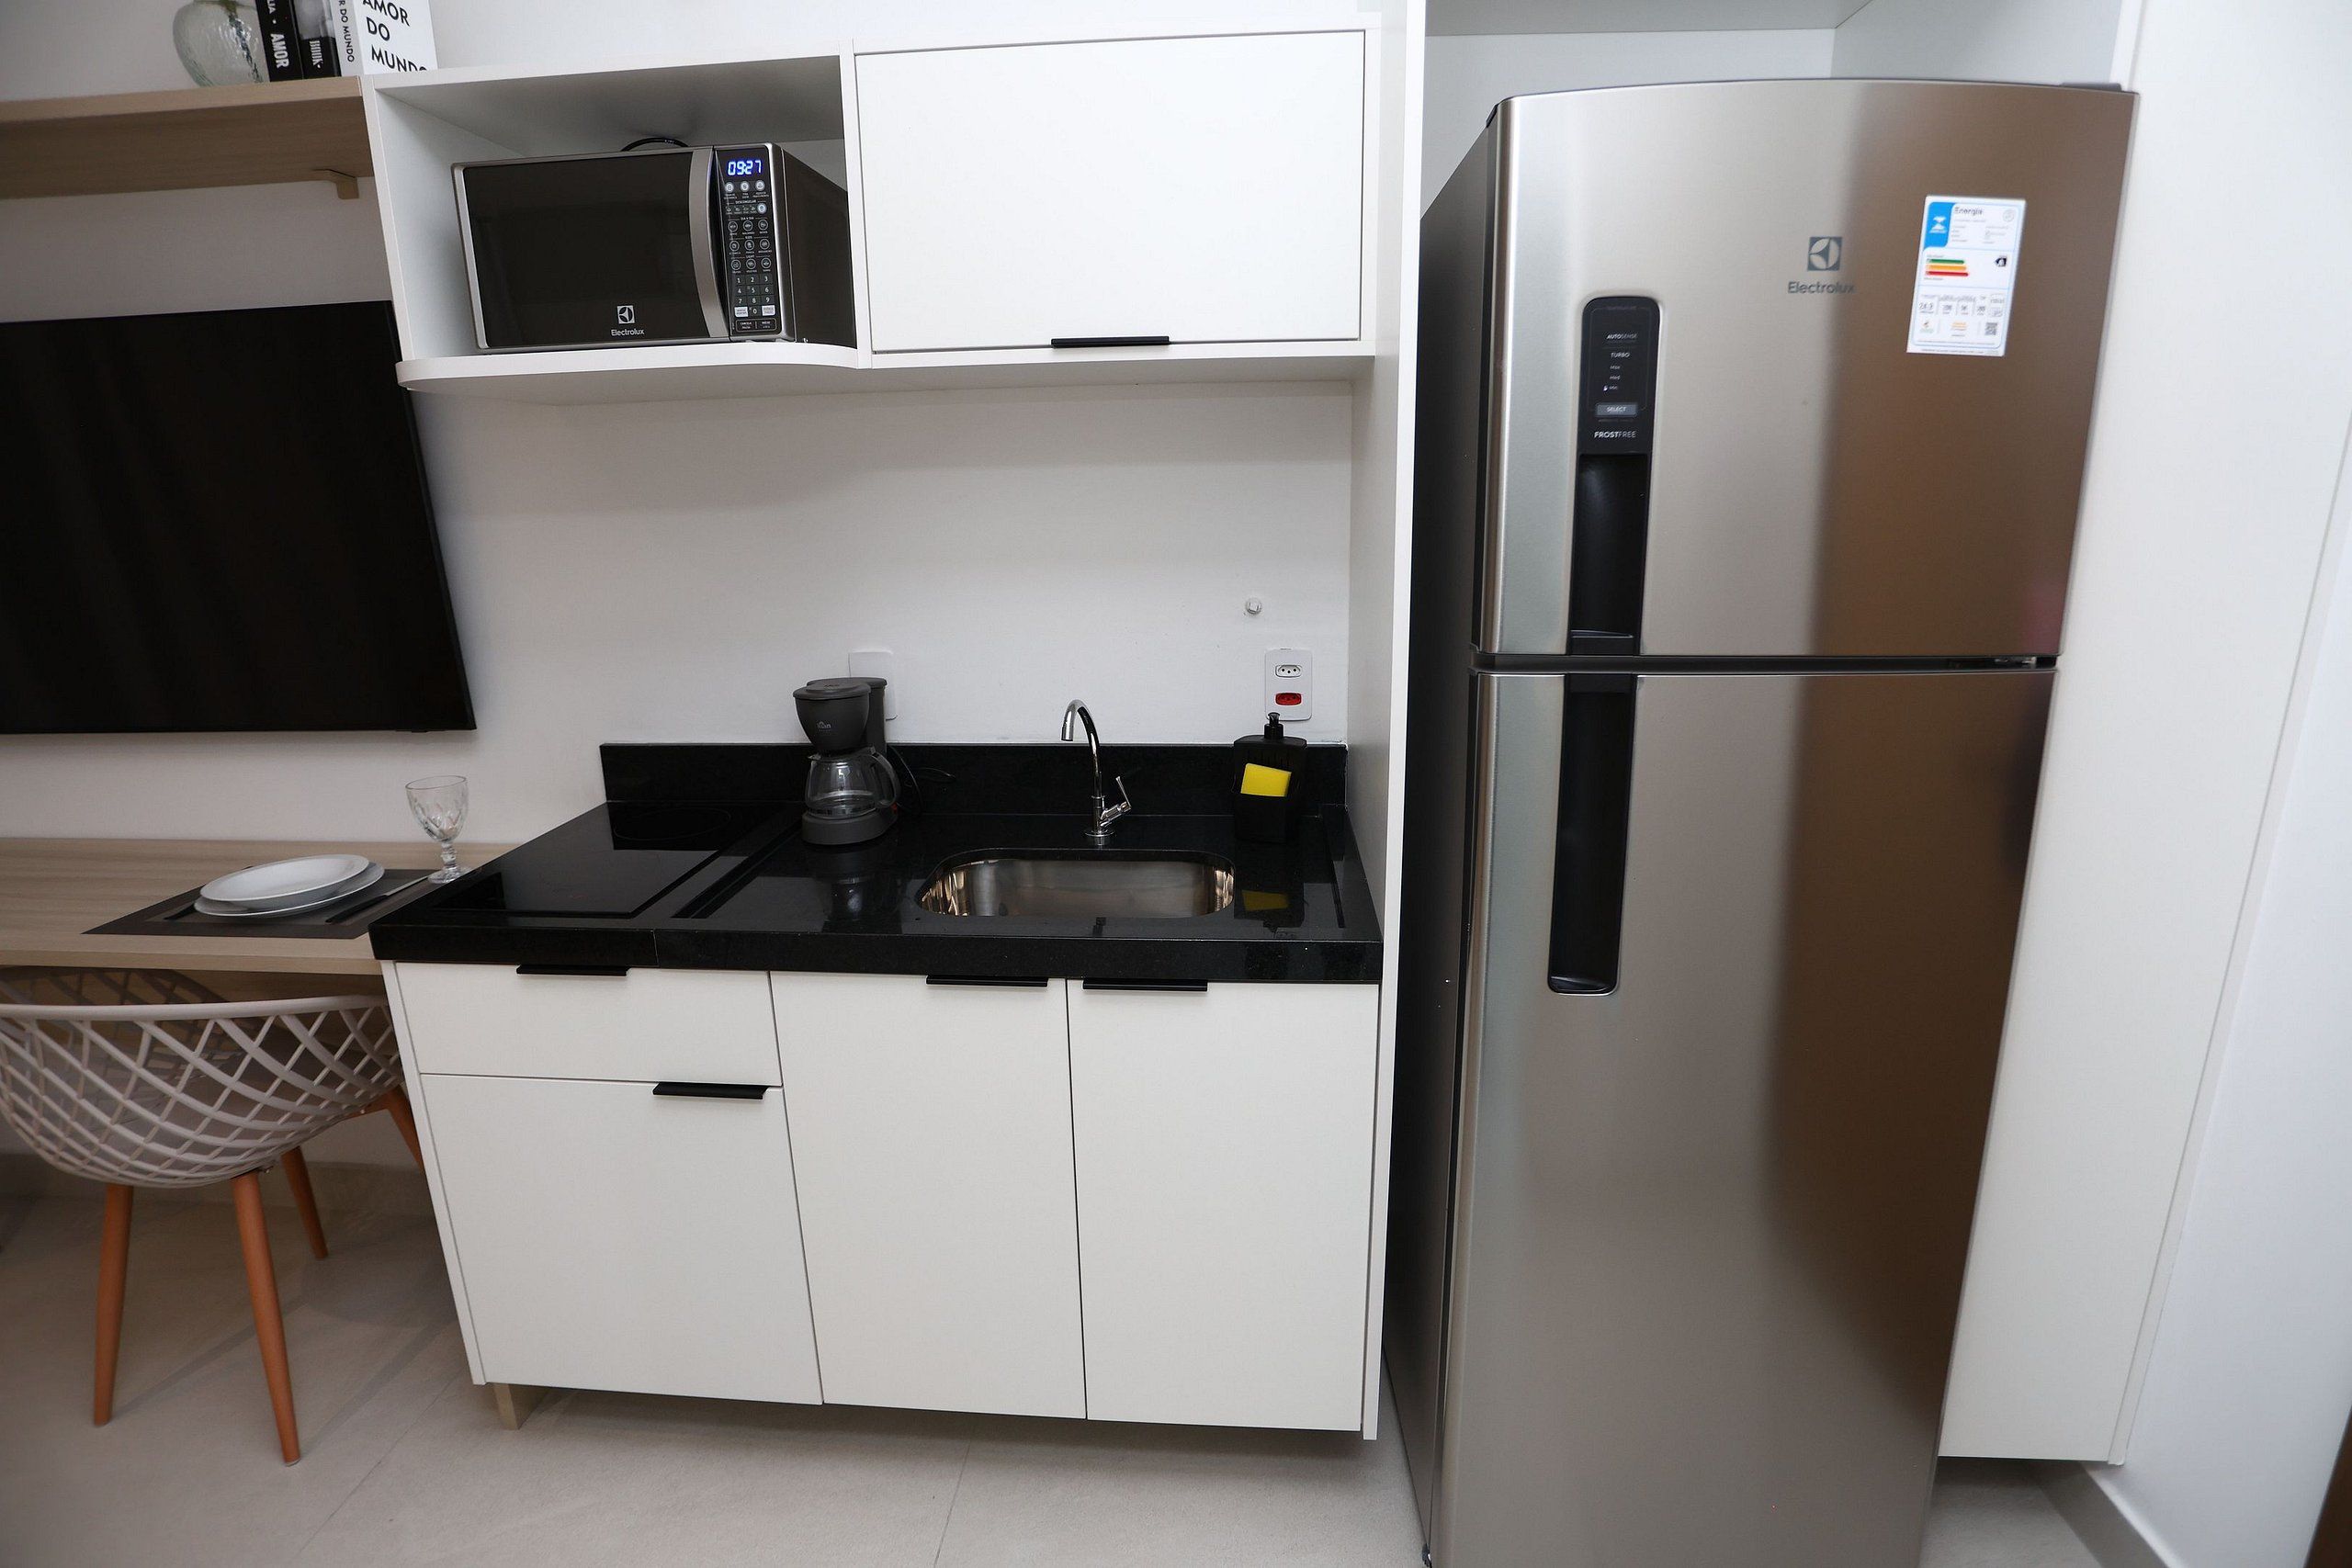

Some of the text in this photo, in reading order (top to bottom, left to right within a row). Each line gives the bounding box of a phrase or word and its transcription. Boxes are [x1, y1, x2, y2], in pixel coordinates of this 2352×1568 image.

[340, 8, 349, 23] DO
[366, 17, 390, 41] DO
[269, 33, 289, 69] AMOR
[342, 26, 356, 62] MUNDO
[370, 44, 427, 73] MUND
[728, 160, 762, 175] 09:27
[1954, 207, 1984, 216] Energia
[1788, 281, 1854, 294] Electrolux
[610, 328, 645, 336] Electrolux
